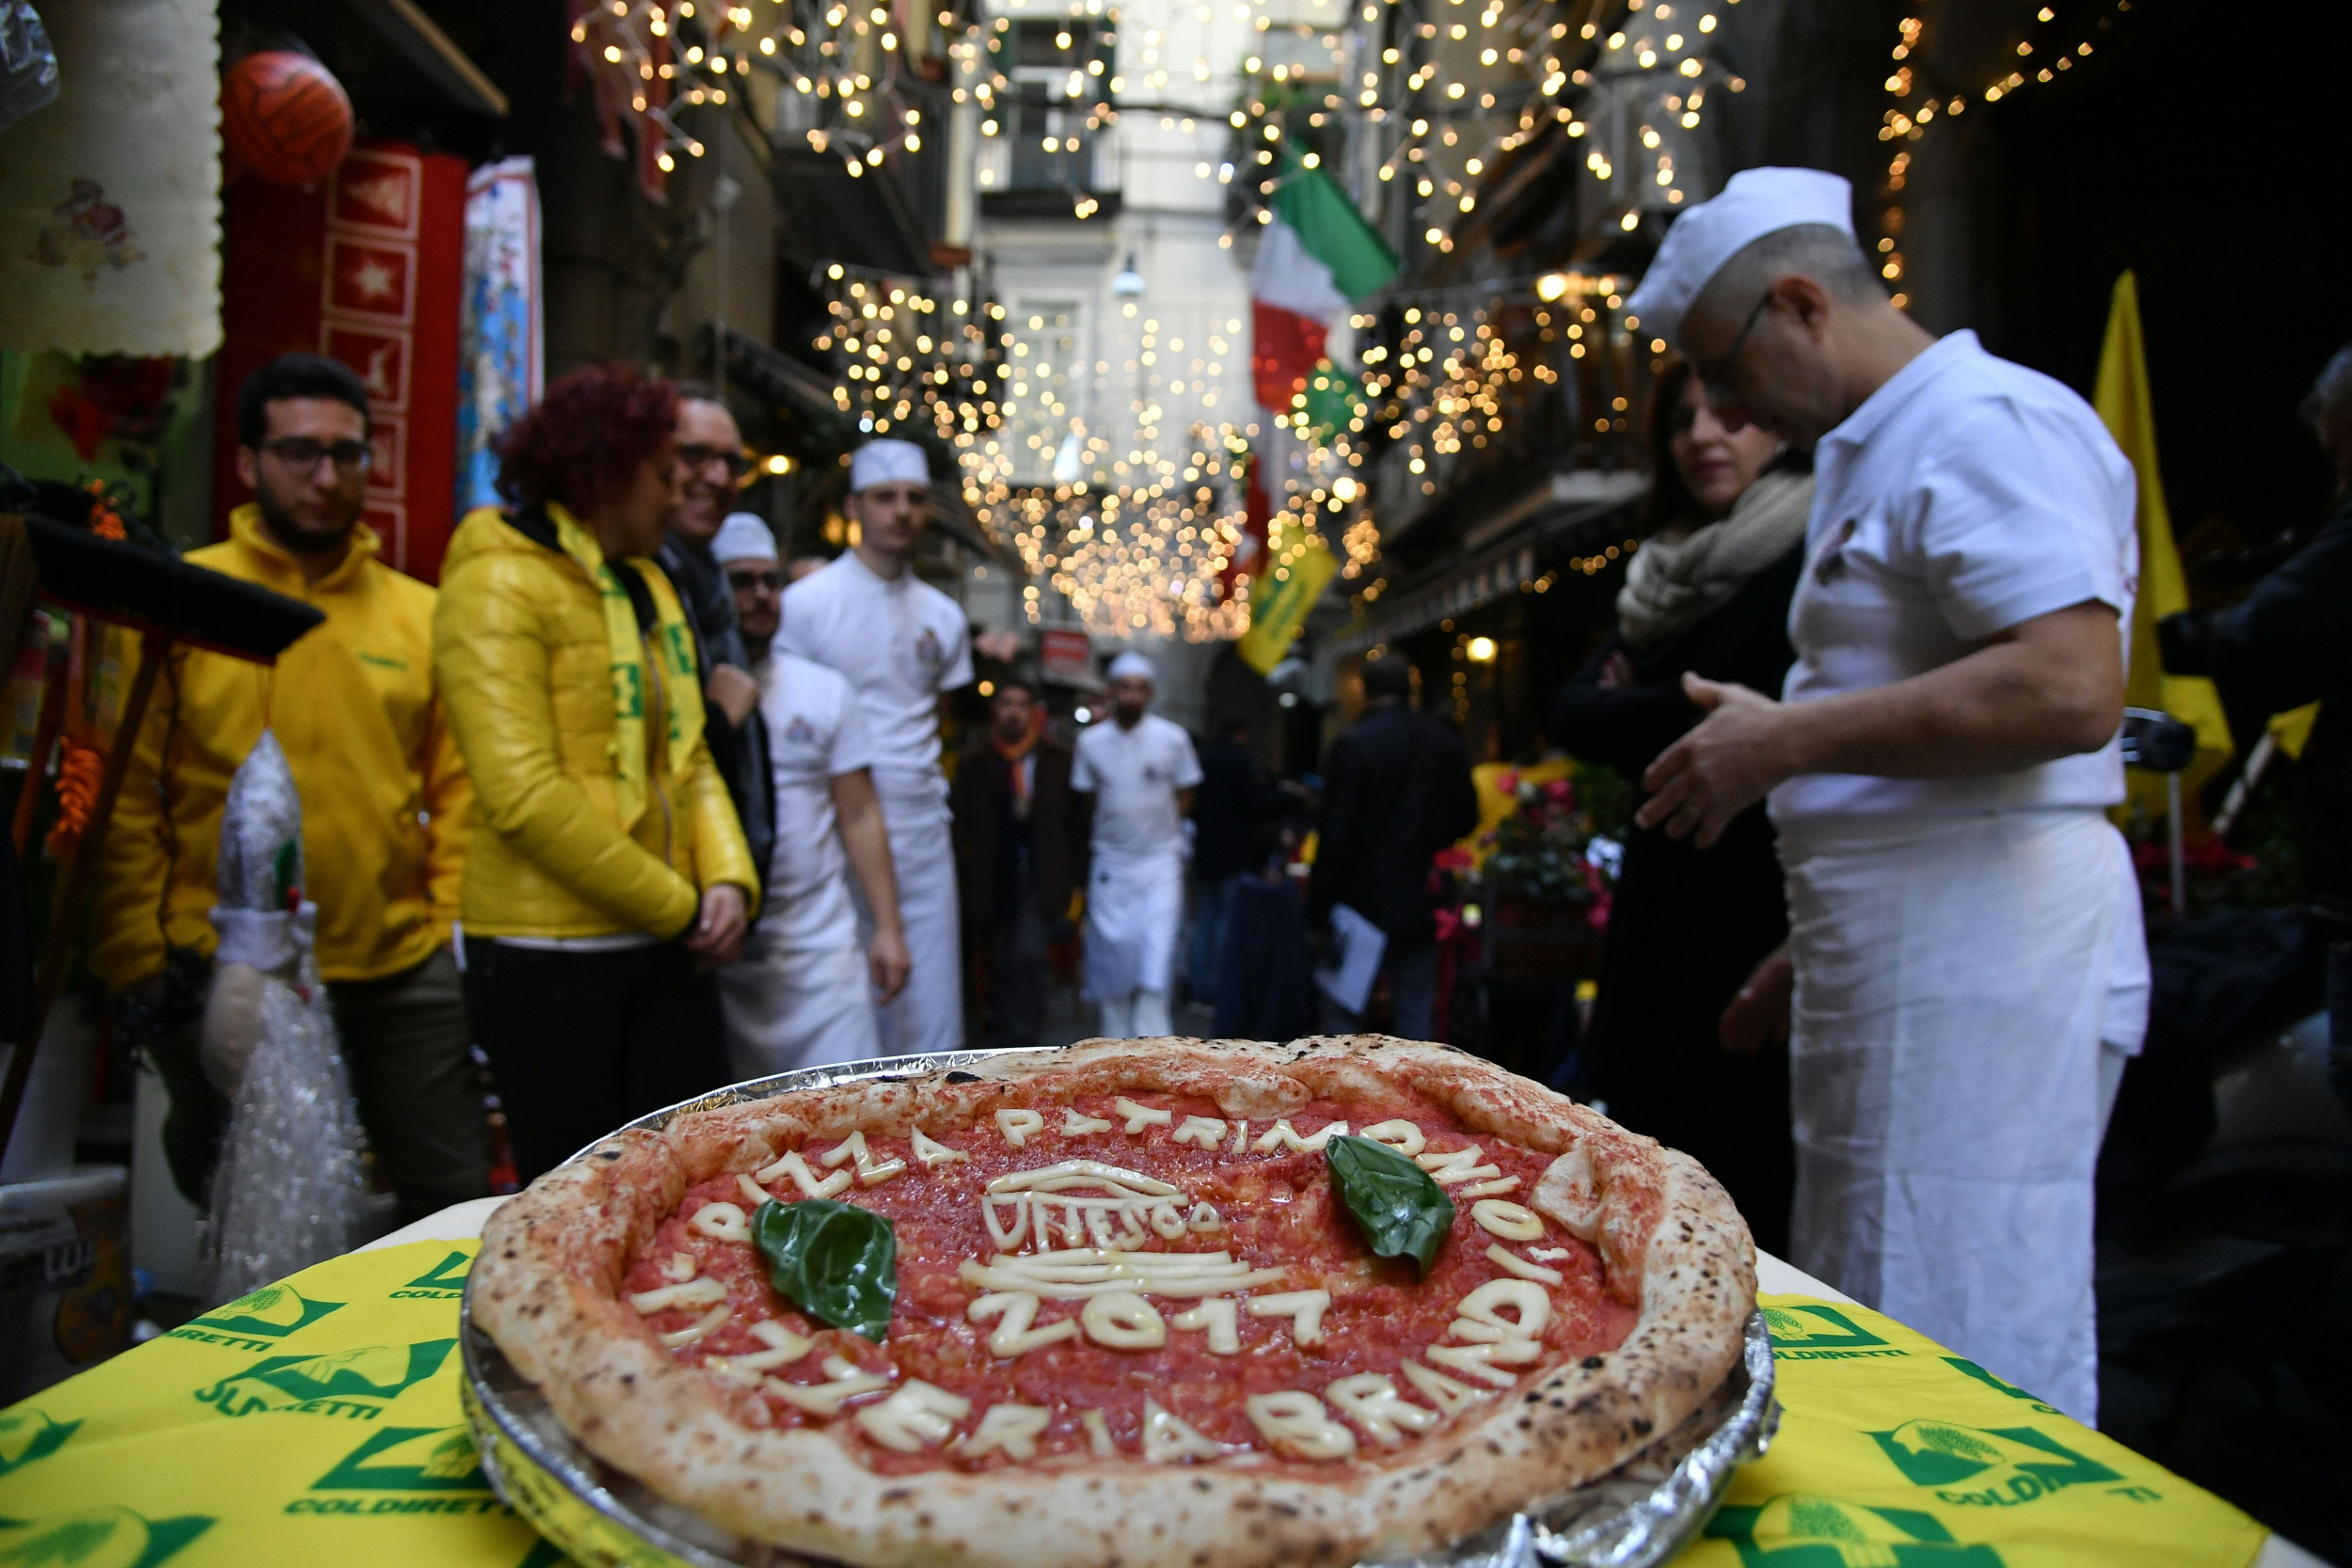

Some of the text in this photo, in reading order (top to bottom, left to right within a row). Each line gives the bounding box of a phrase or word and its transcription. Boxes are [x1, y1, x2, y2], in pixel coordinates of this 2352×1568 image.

[687, 1097, 1545, 1243] PIZZA PATRIMONIO
[969, 1290, 1330, 1358] 2017
[1246, 1243, 1563, 1458] BRANDI
